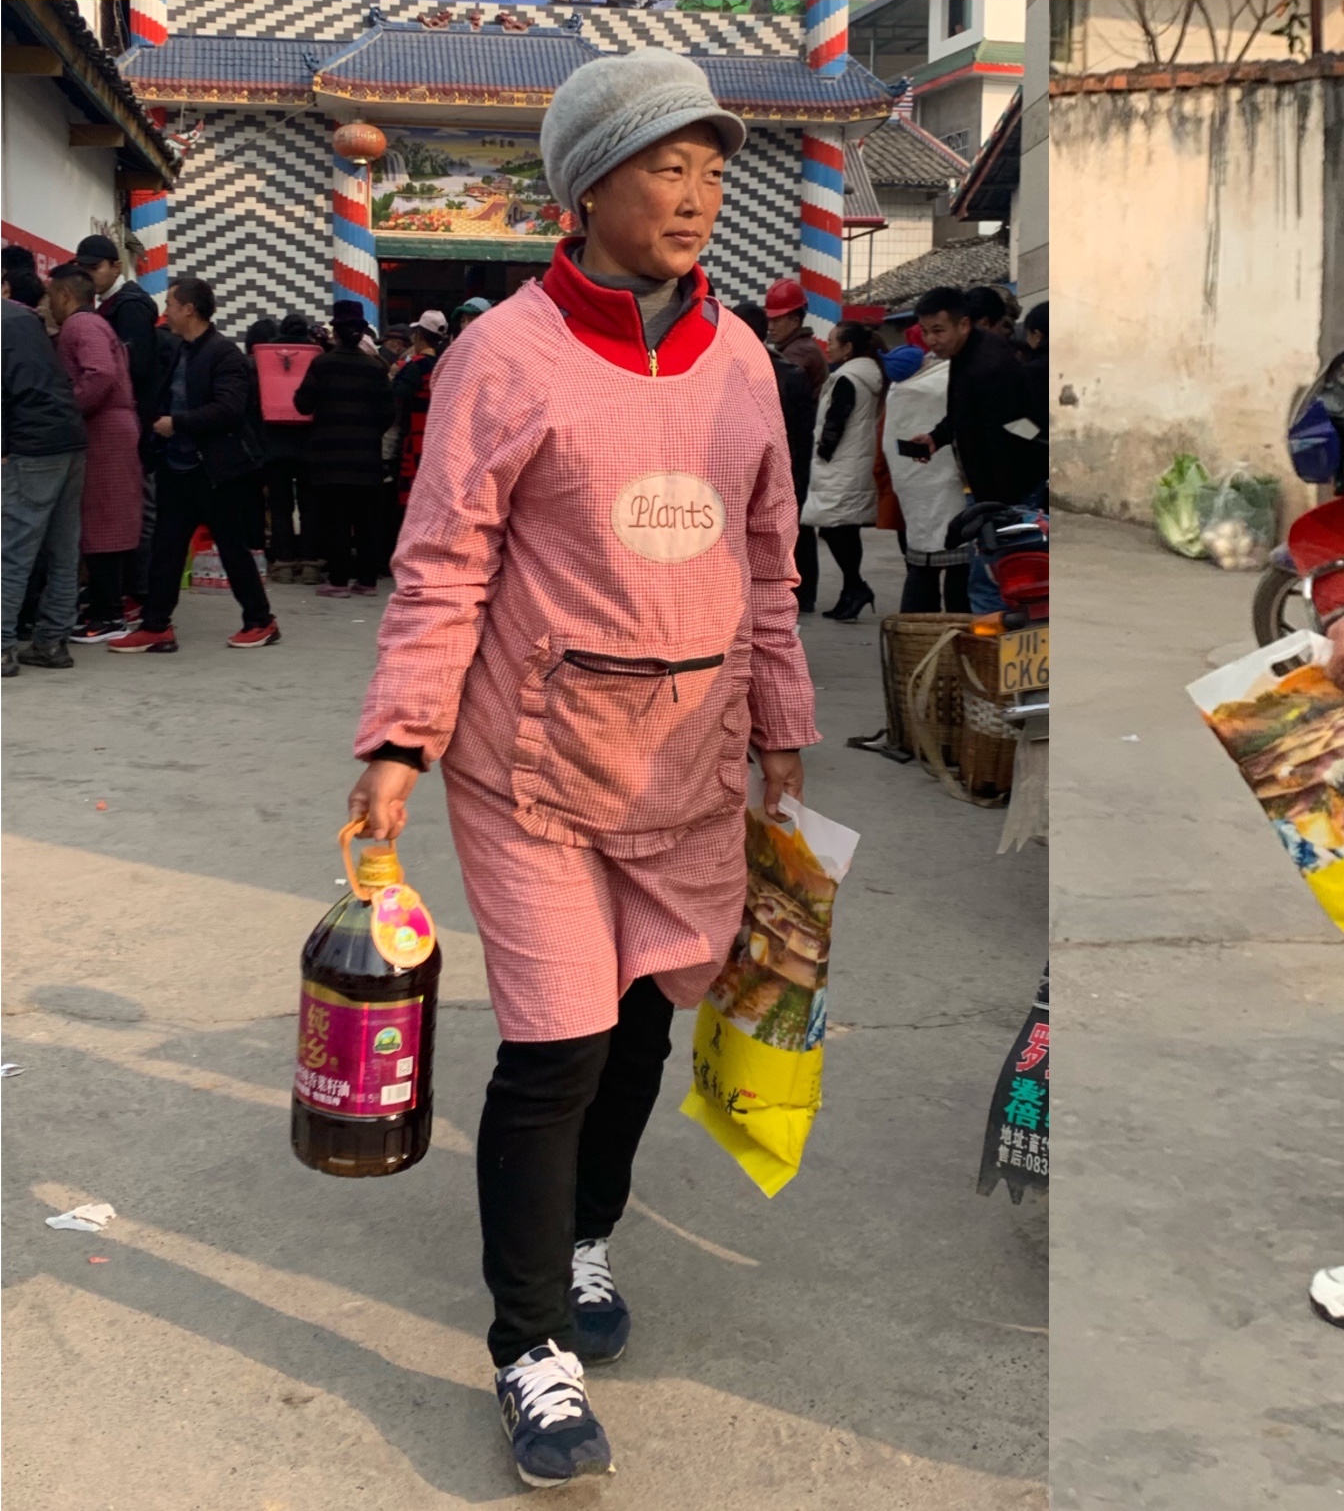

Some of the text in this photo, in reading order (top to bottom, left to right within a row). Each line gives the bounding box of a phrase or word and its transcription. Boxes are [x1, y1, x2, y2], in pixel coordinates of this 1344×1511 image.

[627, 494, 714, 530] Plants
[1004, 656, 1049, 689] CK6
[1015, 1023, 1049, 1080] 罗
[1003, 1100, 1049, 1131] 倍
[997, 1144, 1049, 1177] 售后:083
